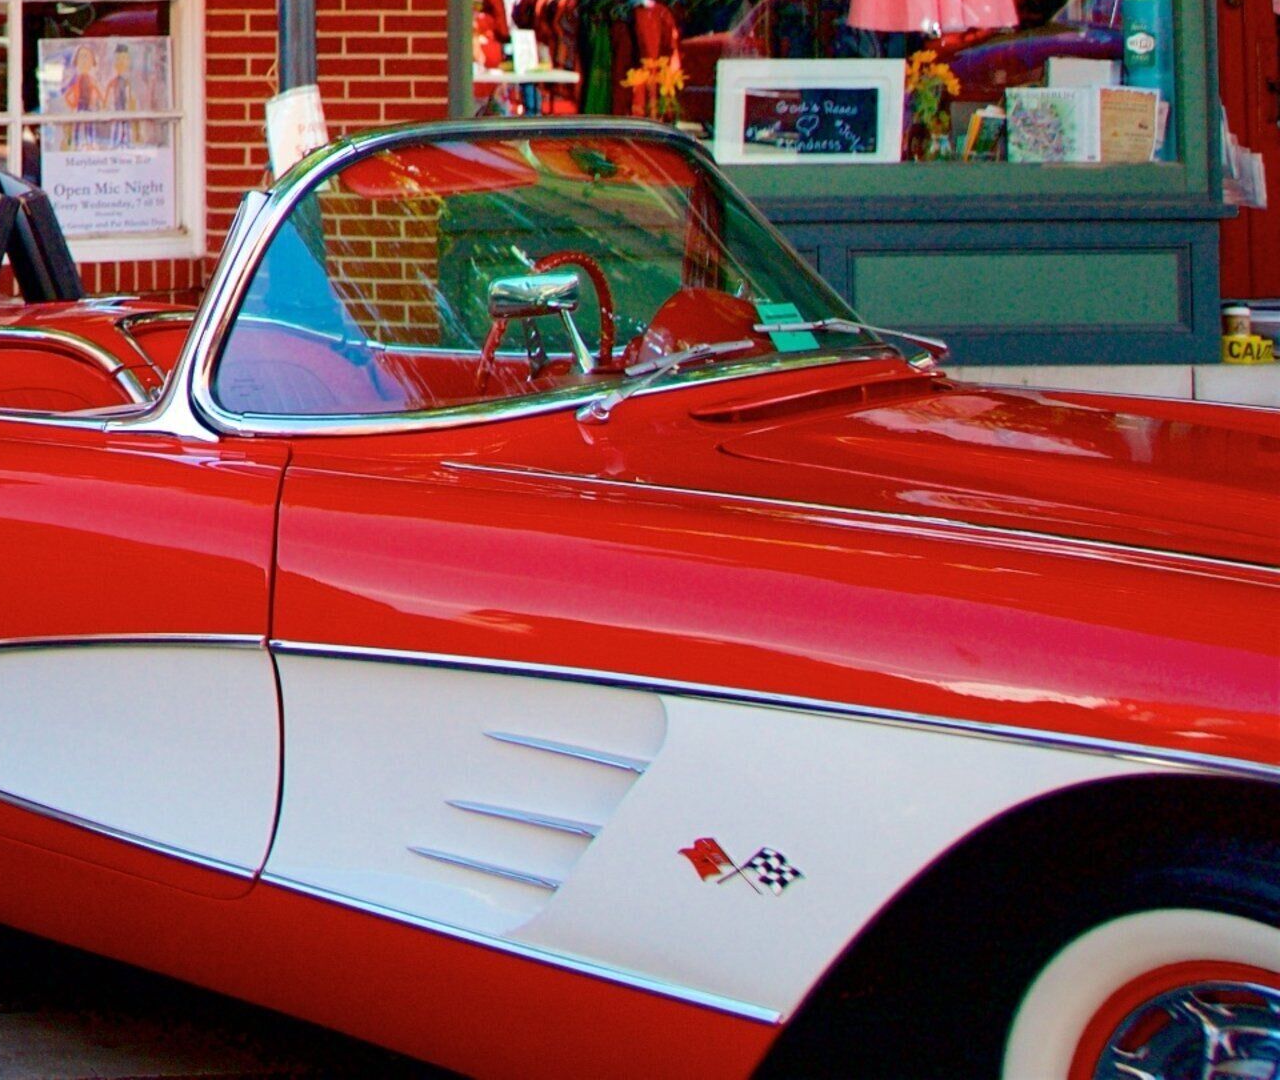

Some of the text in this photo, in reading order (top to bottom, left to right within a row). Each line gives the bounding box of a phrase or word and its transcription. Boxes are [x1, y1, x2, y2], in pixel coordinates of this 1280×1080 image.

[53, 179, 164, 200] Open Mic Night
